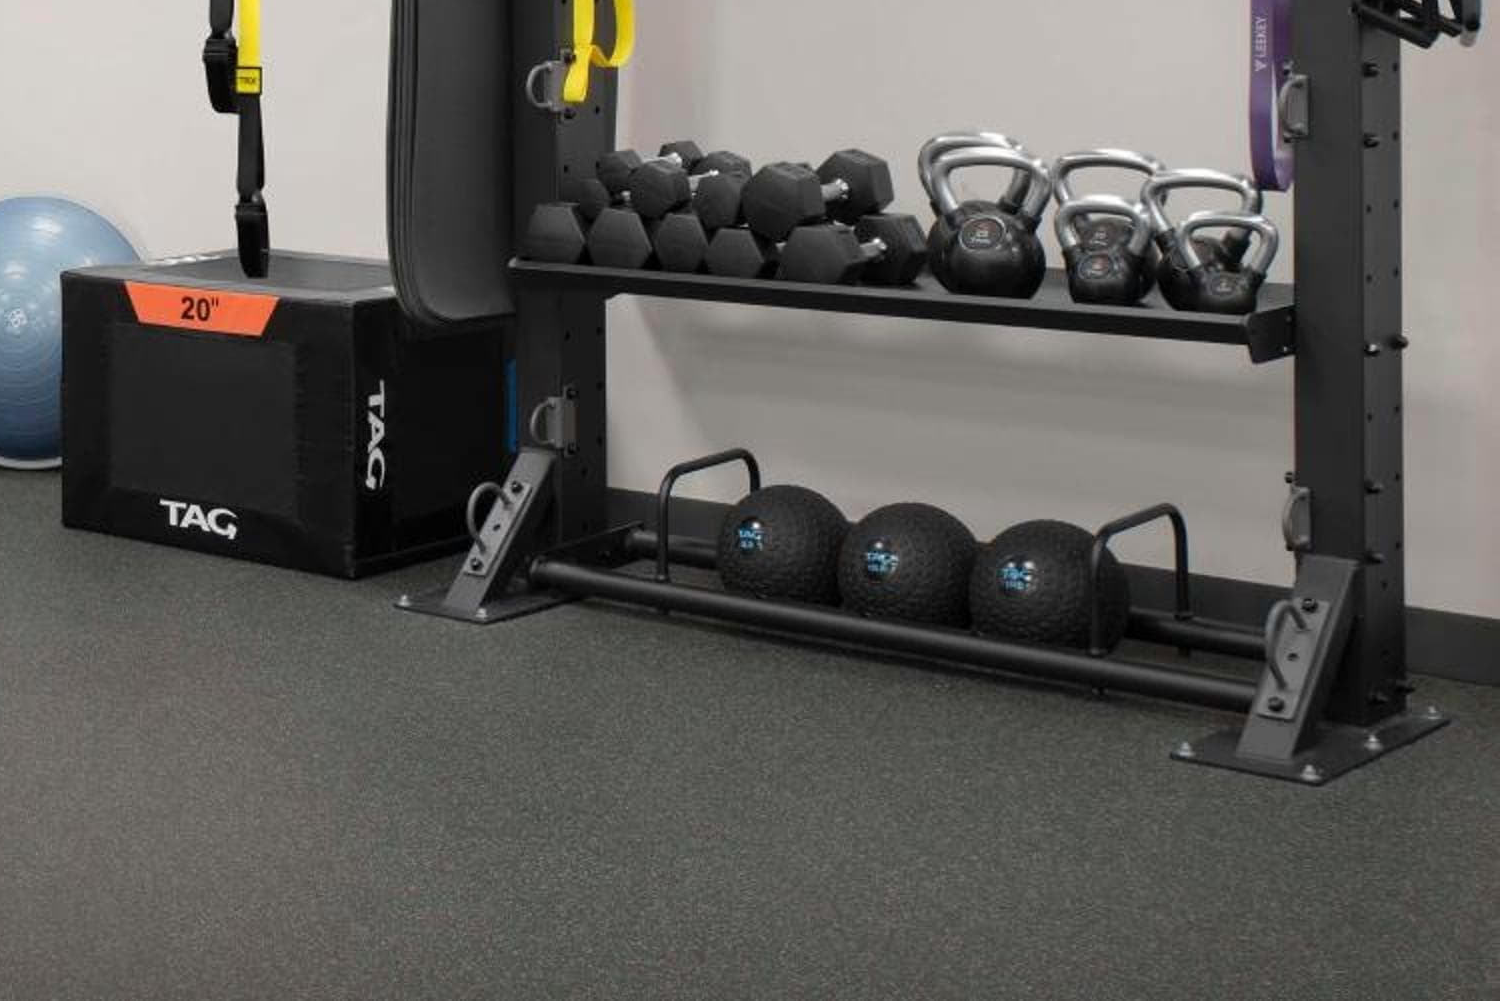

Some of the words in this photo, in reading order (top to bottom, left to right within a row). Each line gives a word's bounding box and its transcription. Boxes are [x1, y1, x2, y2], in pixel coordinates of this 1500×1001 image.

[181, 296, 220, 322] 20"
[364, 378, 385, 490] TAG
[159, 498, 238, 540] TAG
